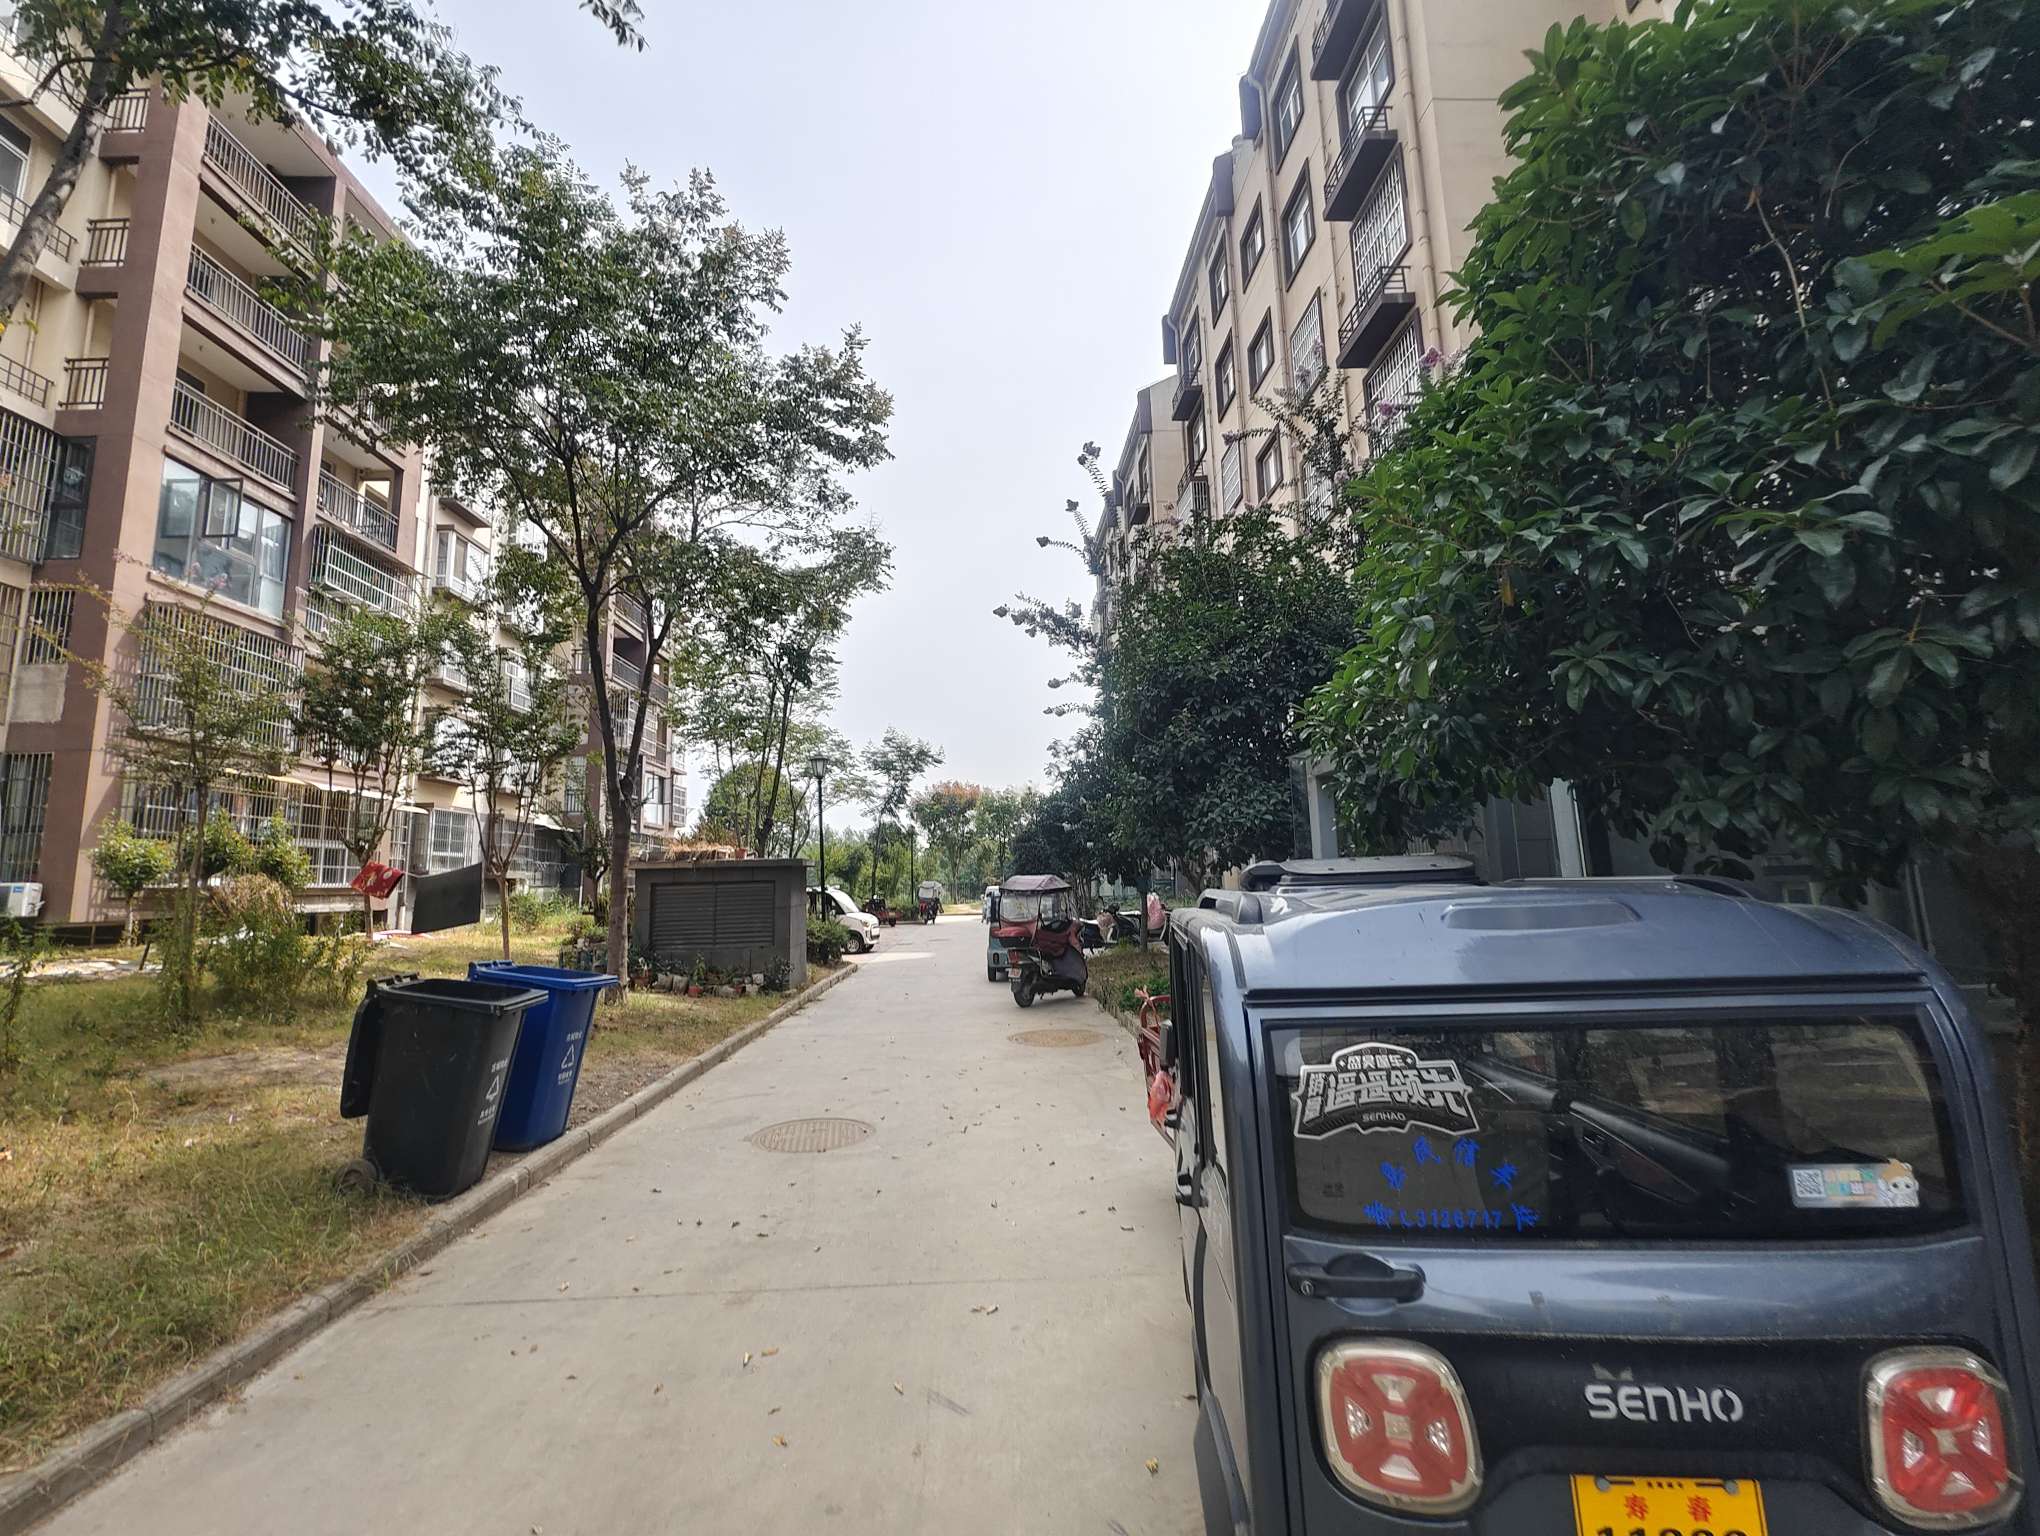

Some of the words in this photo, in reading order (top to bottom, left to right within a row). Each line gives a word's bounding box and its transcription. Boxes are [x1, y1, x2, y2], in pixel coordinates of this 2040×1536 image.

[1324, 1069, 1473, 1118] 遥遥领先
[1583, 1384, 1745, 1423] SENHO
